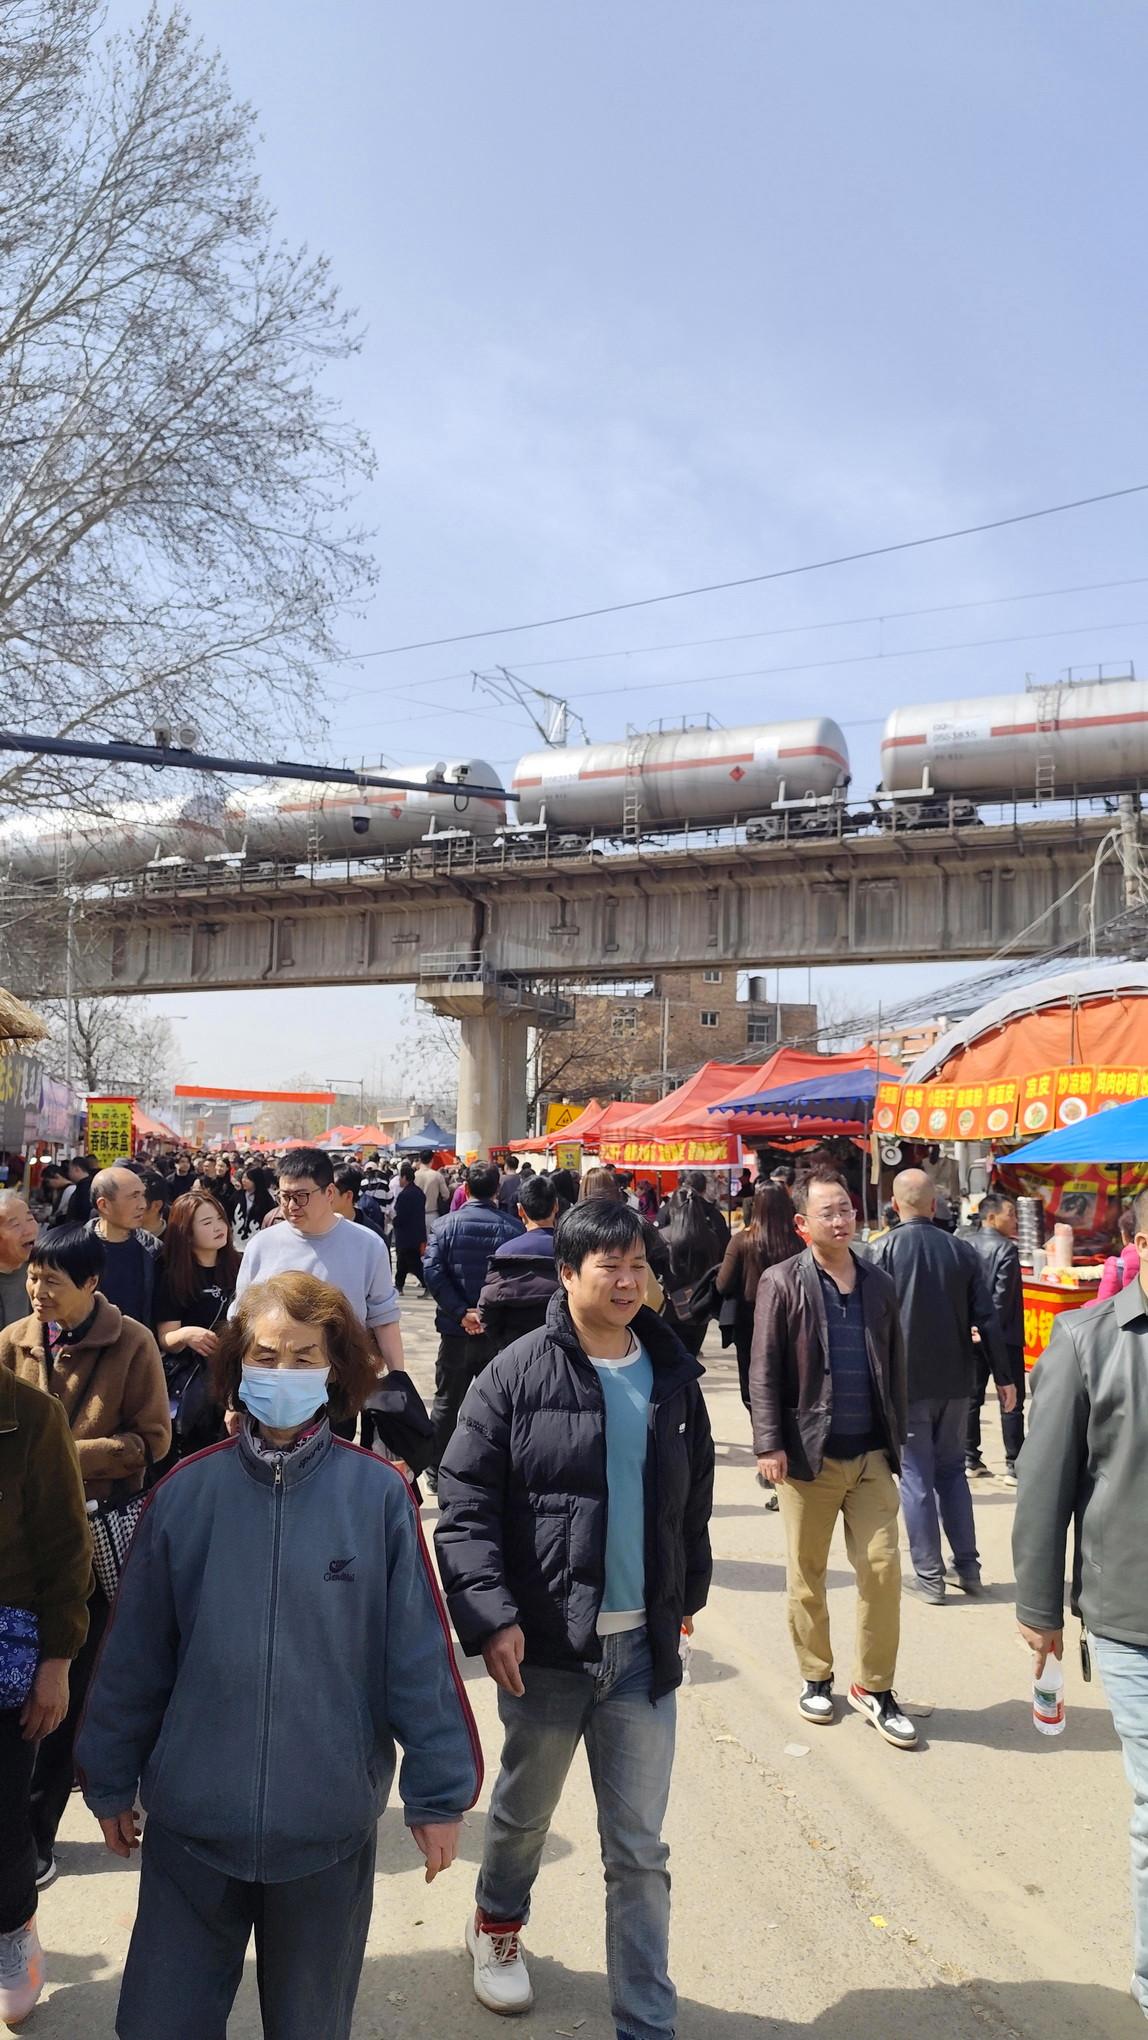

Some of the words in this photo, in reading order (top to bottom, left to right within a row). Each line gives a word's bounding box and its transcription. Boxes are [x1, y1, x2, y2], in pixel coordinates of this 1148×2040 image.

[1057, 1072, 1091, 1095] 炒凉粉
[1096, 1072, 1138, 1096] 鸡肉砂锅
[91, 1130, 128, 1152] 香酥菜盒
[298, 1440, 324, 1469] sports
